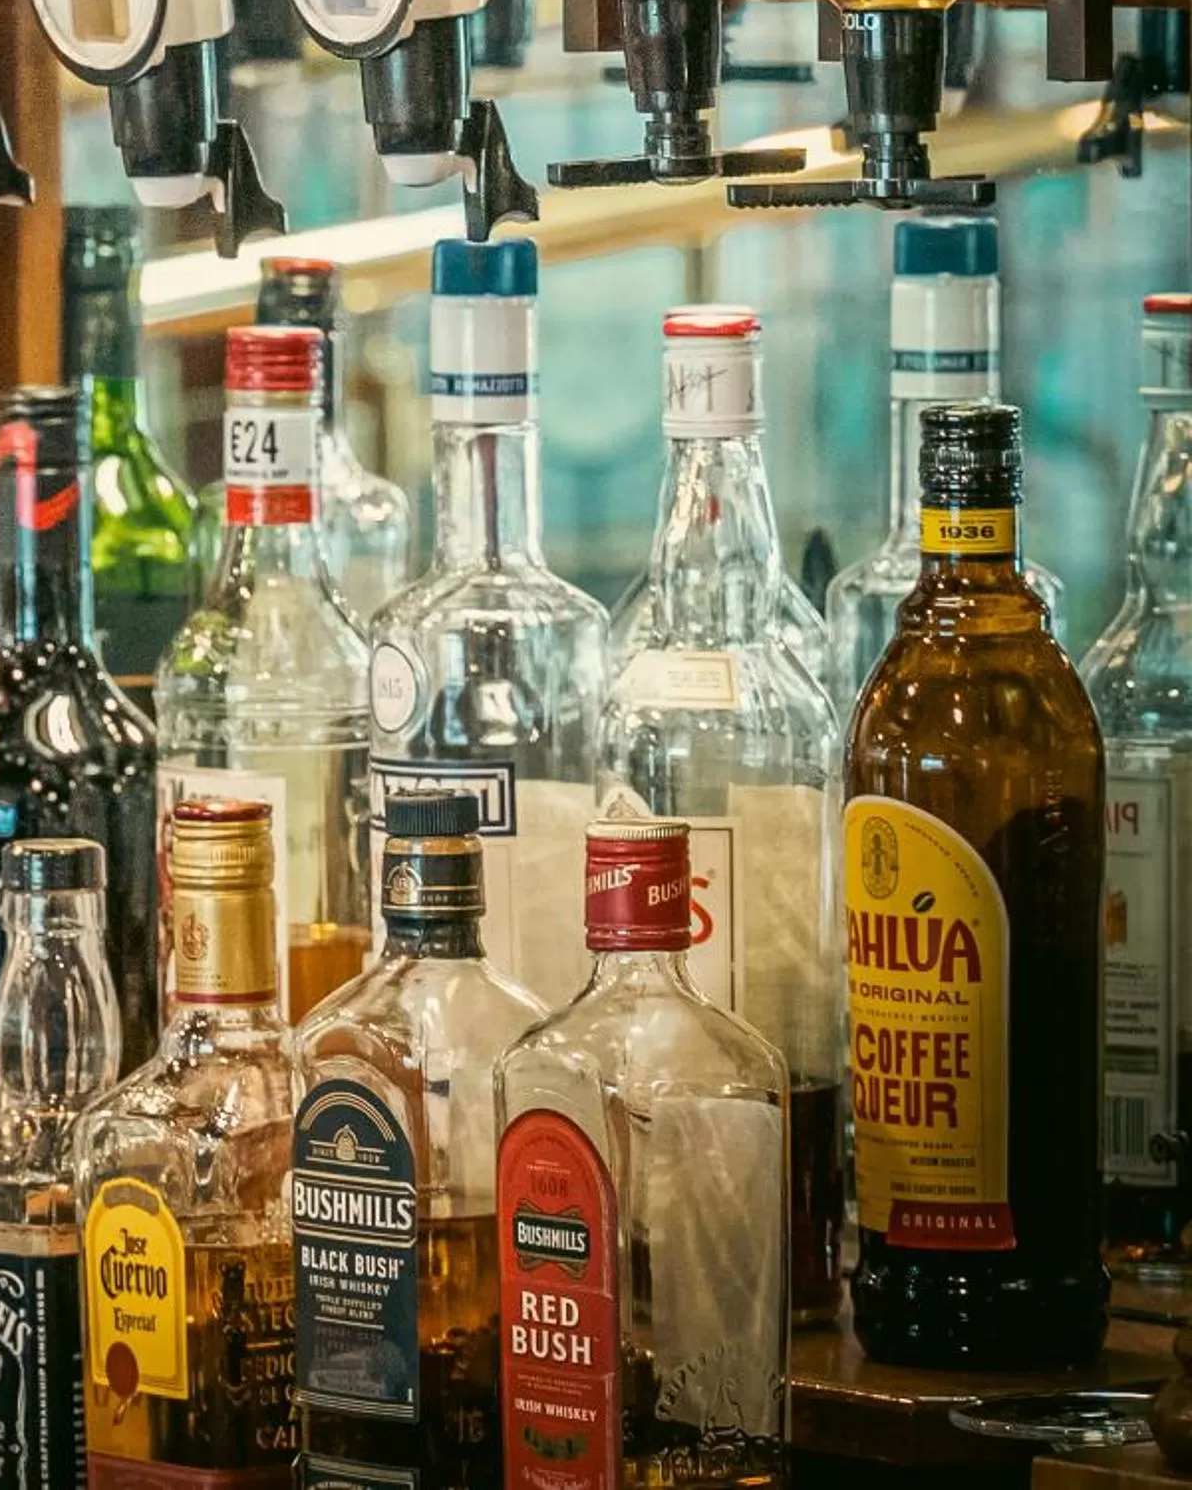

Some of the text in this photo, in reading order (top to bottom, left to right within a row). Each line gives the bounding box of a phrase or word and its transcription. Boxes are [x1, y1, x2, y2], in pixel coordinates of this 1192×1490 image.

[231, 420, 279, 464] €24
[939, 525, 995, 539] 1936
[647, 876, 688, 907] BUSH
[859, 983, 970, 1006] ORIGINAL
[855, 1023, 971, 1080] COFFEE
[293, 1180, 414, 1232] BUSHMILLS
[901, 1213, 997, 1229] ORIGINAL
[120, 1227, 147, 1259] Jose
[517, 1221, 587, 1254] BUSHMILLS
[99, 1245, 169, 1301] Cuervo
[300, 1244, 400, 1280] BLACK BUSH
[308, 1273, 391, 1297] IRISH WHISKEY
[112, 1306, 158, 1334] Especial
[520, 1290, 580, 1328] RED
[511, 1325, 593, 1366] BUSH
[514, 1397, 597, 1423] IRISH WHISKEY
